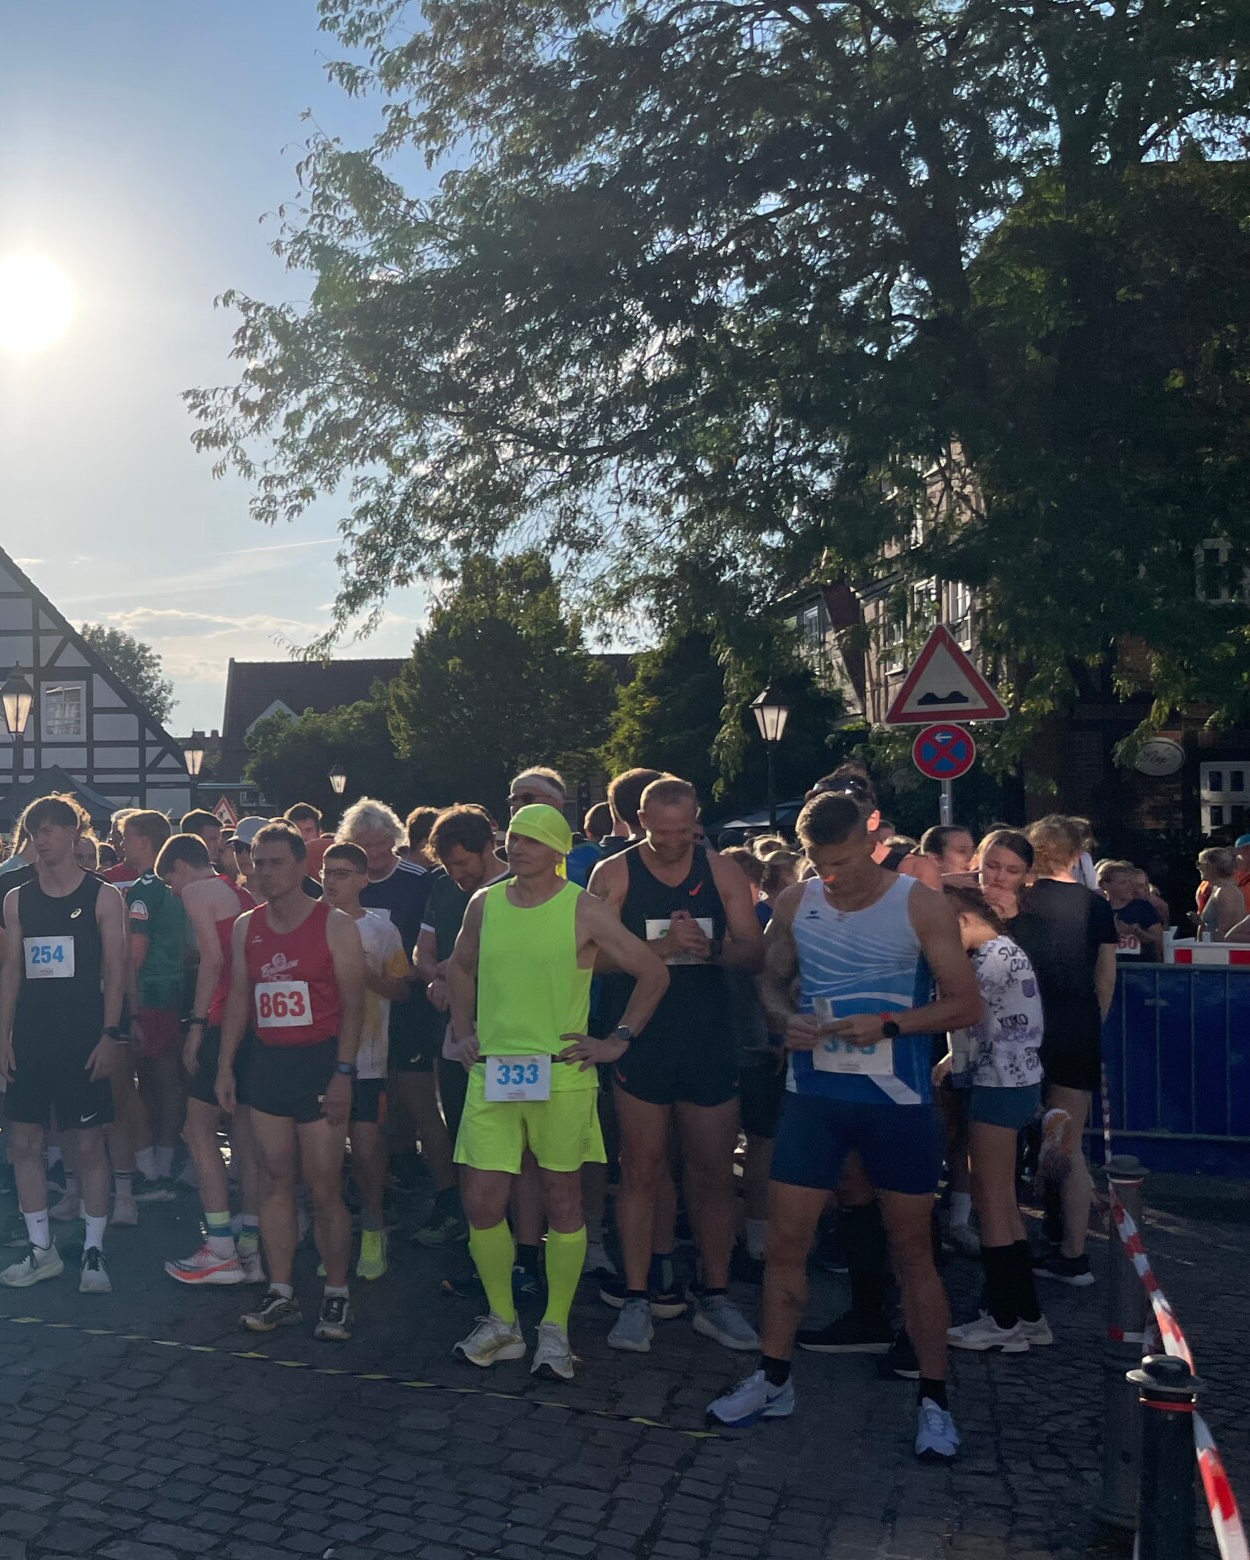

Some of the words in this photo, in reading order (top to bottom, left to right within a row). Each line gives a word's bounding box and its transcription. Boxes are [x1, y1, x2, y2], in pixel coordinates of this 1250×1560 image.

[30, 944, 64, 964] 254
[259, 991, 306, 1018] 863
[496, 1063, 539, 1086] 333
